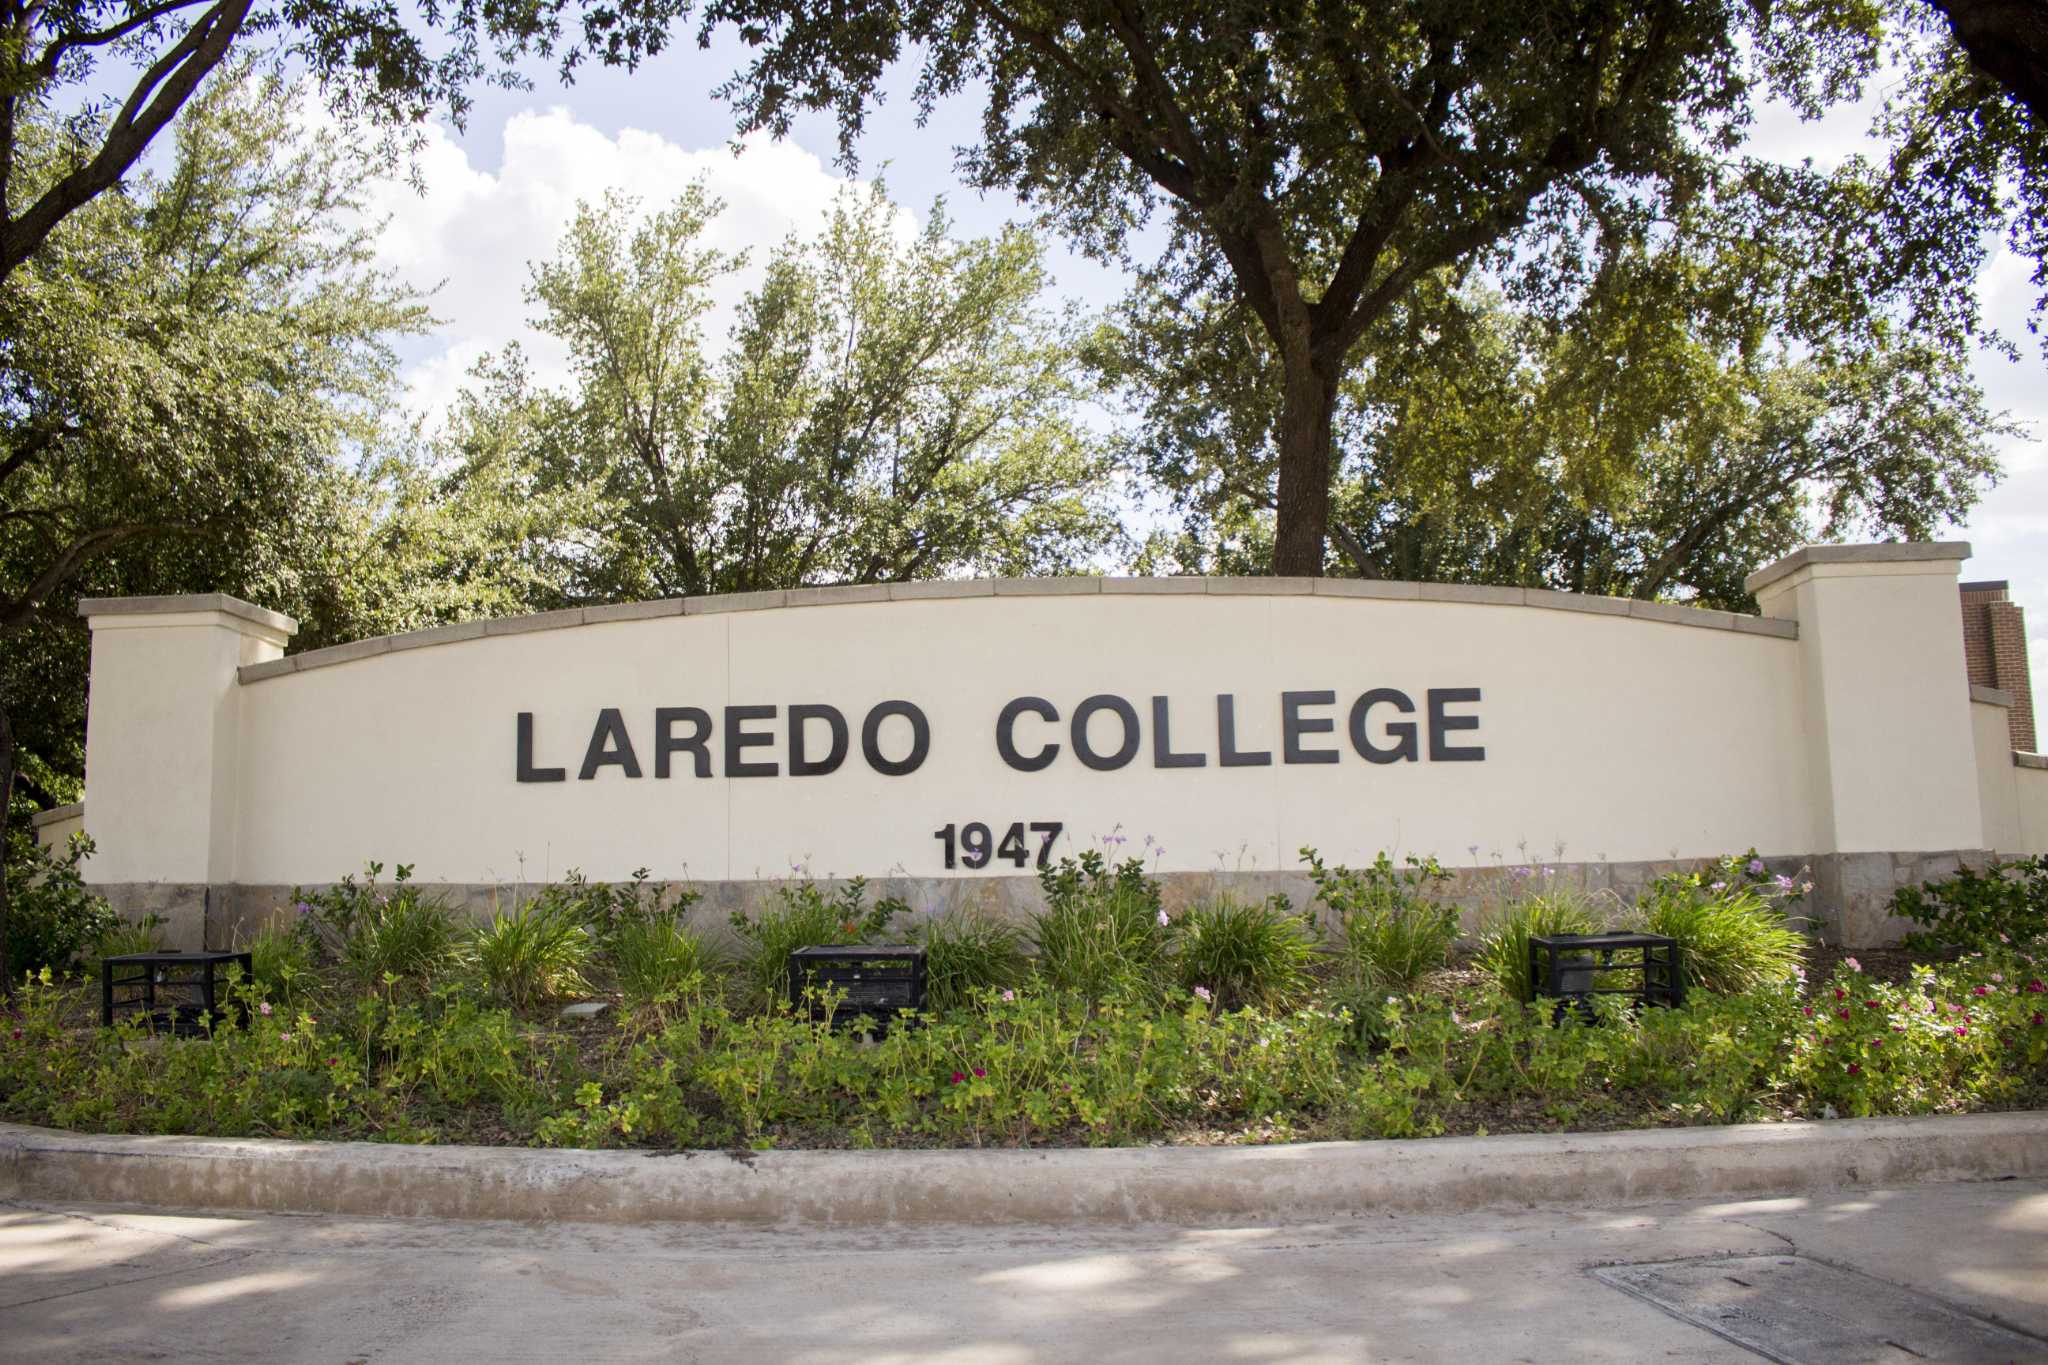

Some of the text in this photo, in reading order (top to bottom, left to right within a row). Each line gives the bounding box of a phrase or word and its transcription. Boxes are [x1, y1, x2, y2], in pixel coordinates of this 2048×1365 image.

[517, 687, 1486, 783] LAREDO COLLEGE
[934, 821, 1063, 870] 1947
